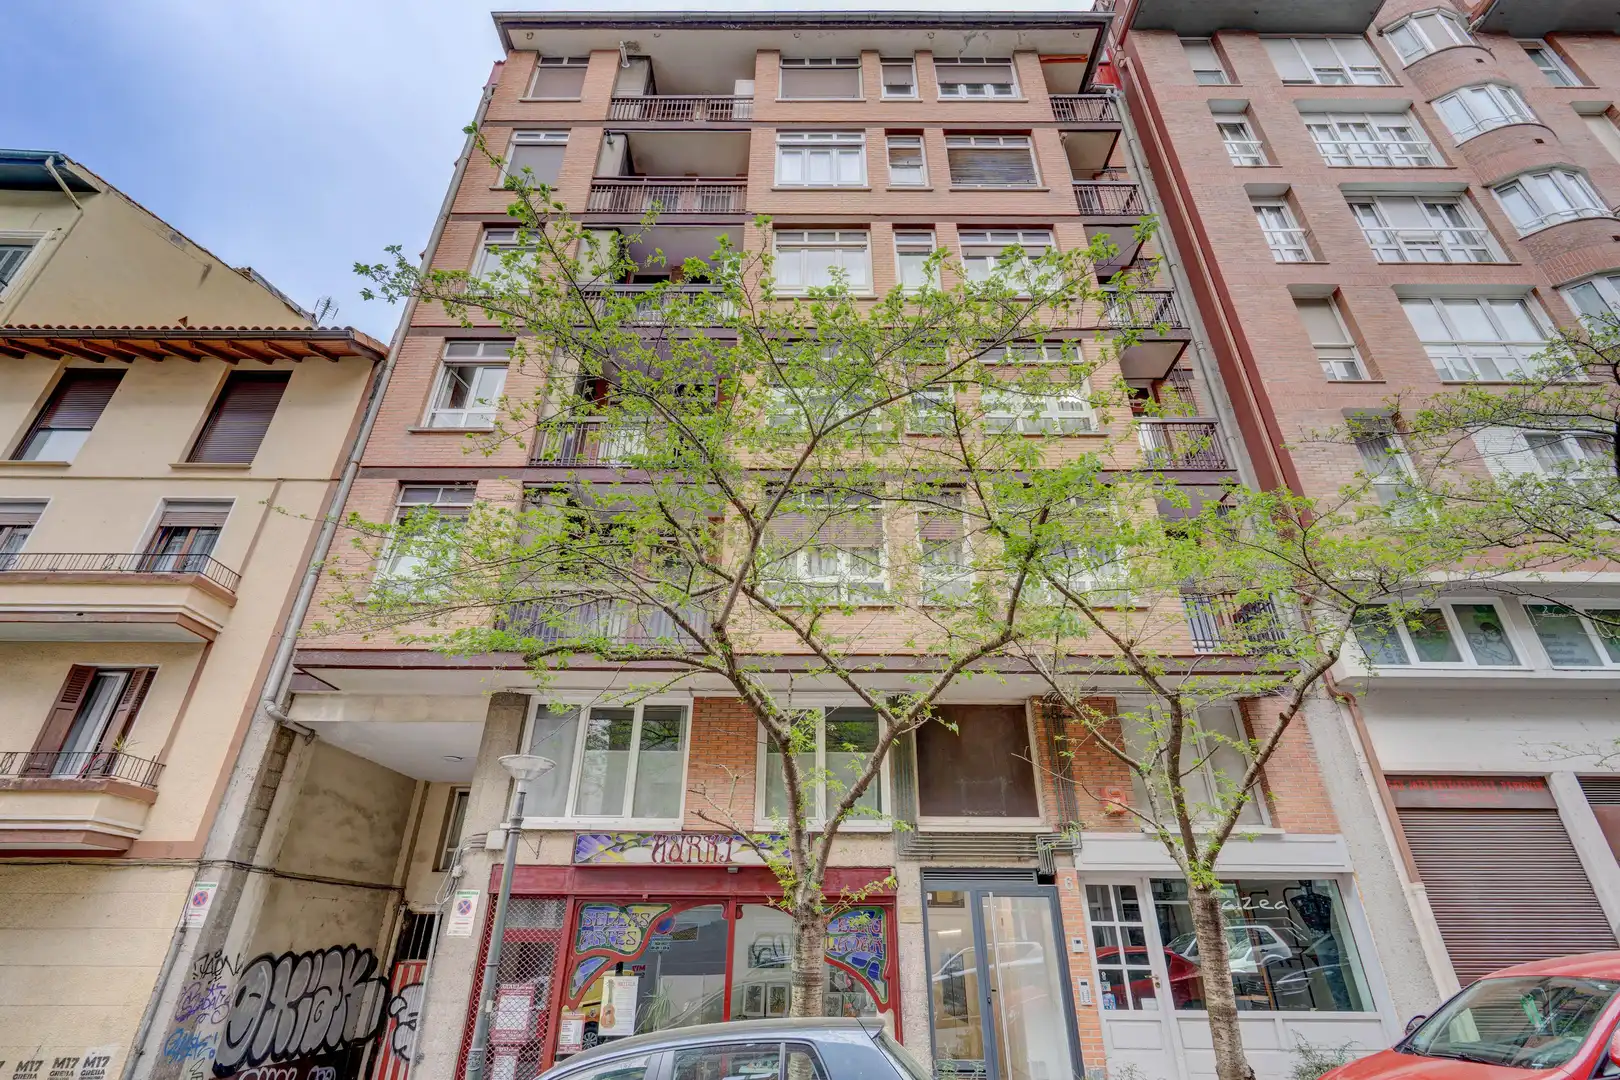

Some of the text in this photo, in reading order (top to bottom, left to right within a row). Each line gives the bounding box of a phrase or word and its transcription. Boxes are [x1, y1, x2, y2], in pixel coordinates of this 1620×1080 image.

[1064, 876, 1074, 890] 6
[15, 1060, 44, 1073] M17
[52, 1057, 80, 1069] M17
[82, 1056, 111, 1069] M17
